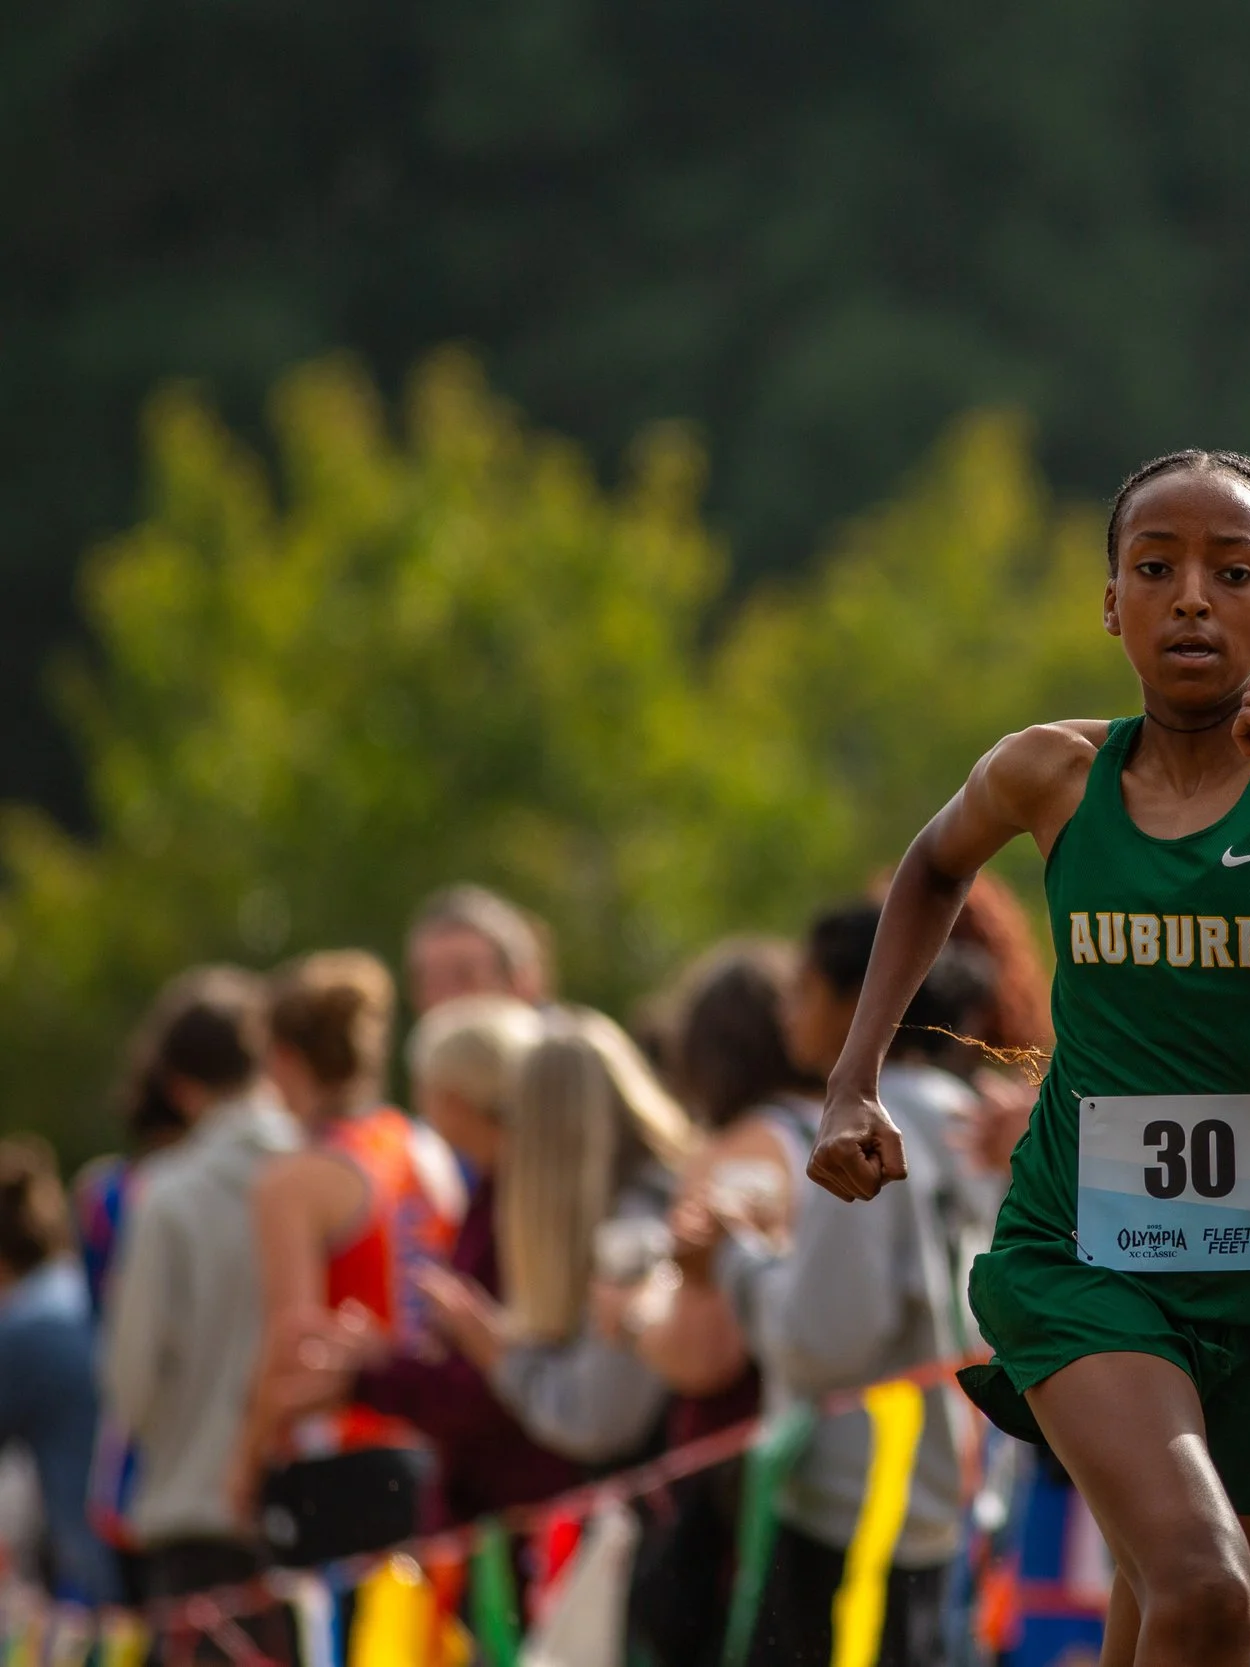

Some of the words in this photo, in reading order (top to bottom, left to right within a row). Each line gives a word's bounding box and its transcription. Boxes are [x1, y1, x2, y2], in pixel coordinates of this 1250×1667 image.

[1143, 1119, 1236, 1200] 30
[1117, 1228, 1188, 1251] OLYMPIA
[1208, 1241, 1249, 1255] FEET
[1143, 1250, 1178, 1258] CLASSIC
